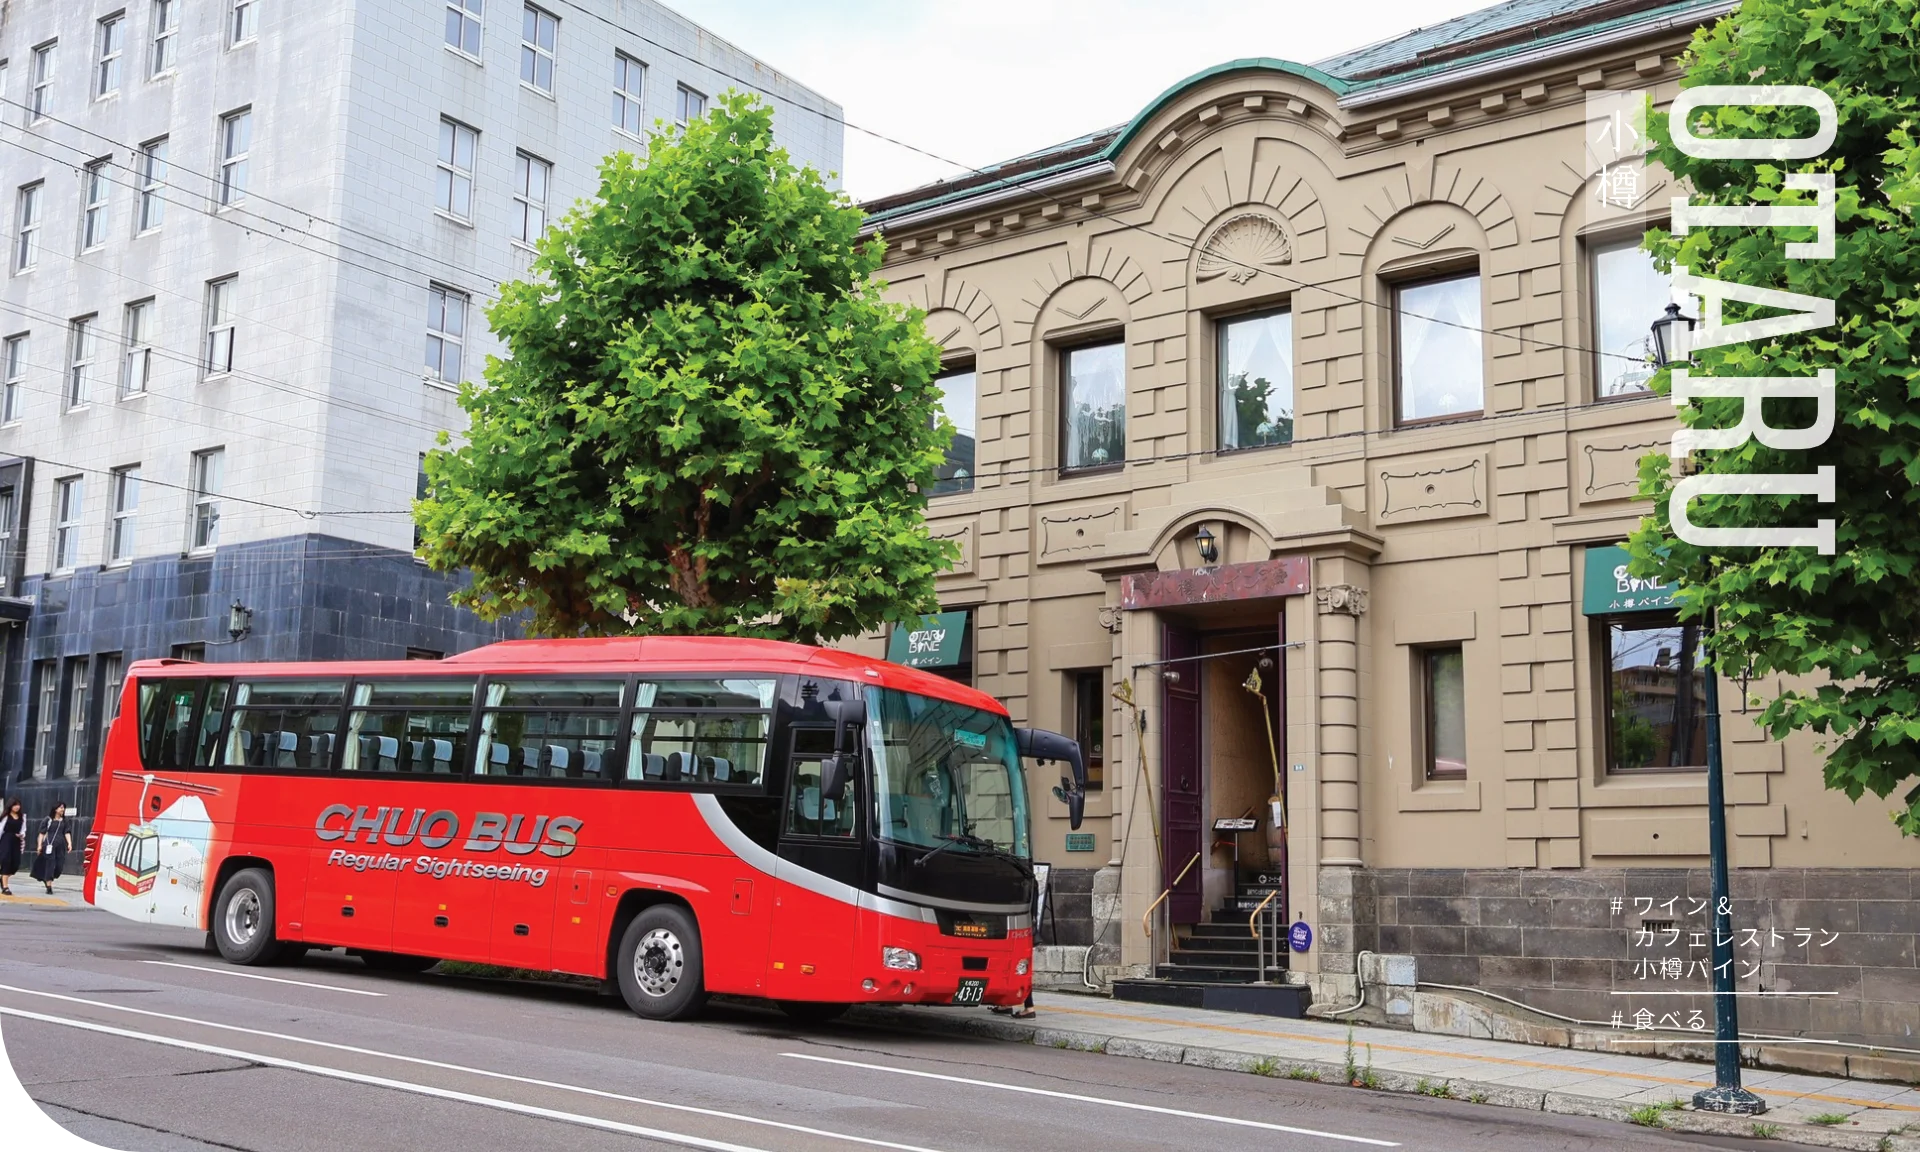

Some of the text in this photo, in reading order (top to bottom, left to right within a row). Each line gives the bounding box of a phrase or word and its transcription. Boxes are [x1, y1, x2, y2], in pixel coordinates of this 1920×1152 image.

[314, 803, 584, 858] CHUO BUS
[327, 849, 549, 887] Regular Sightseeing
